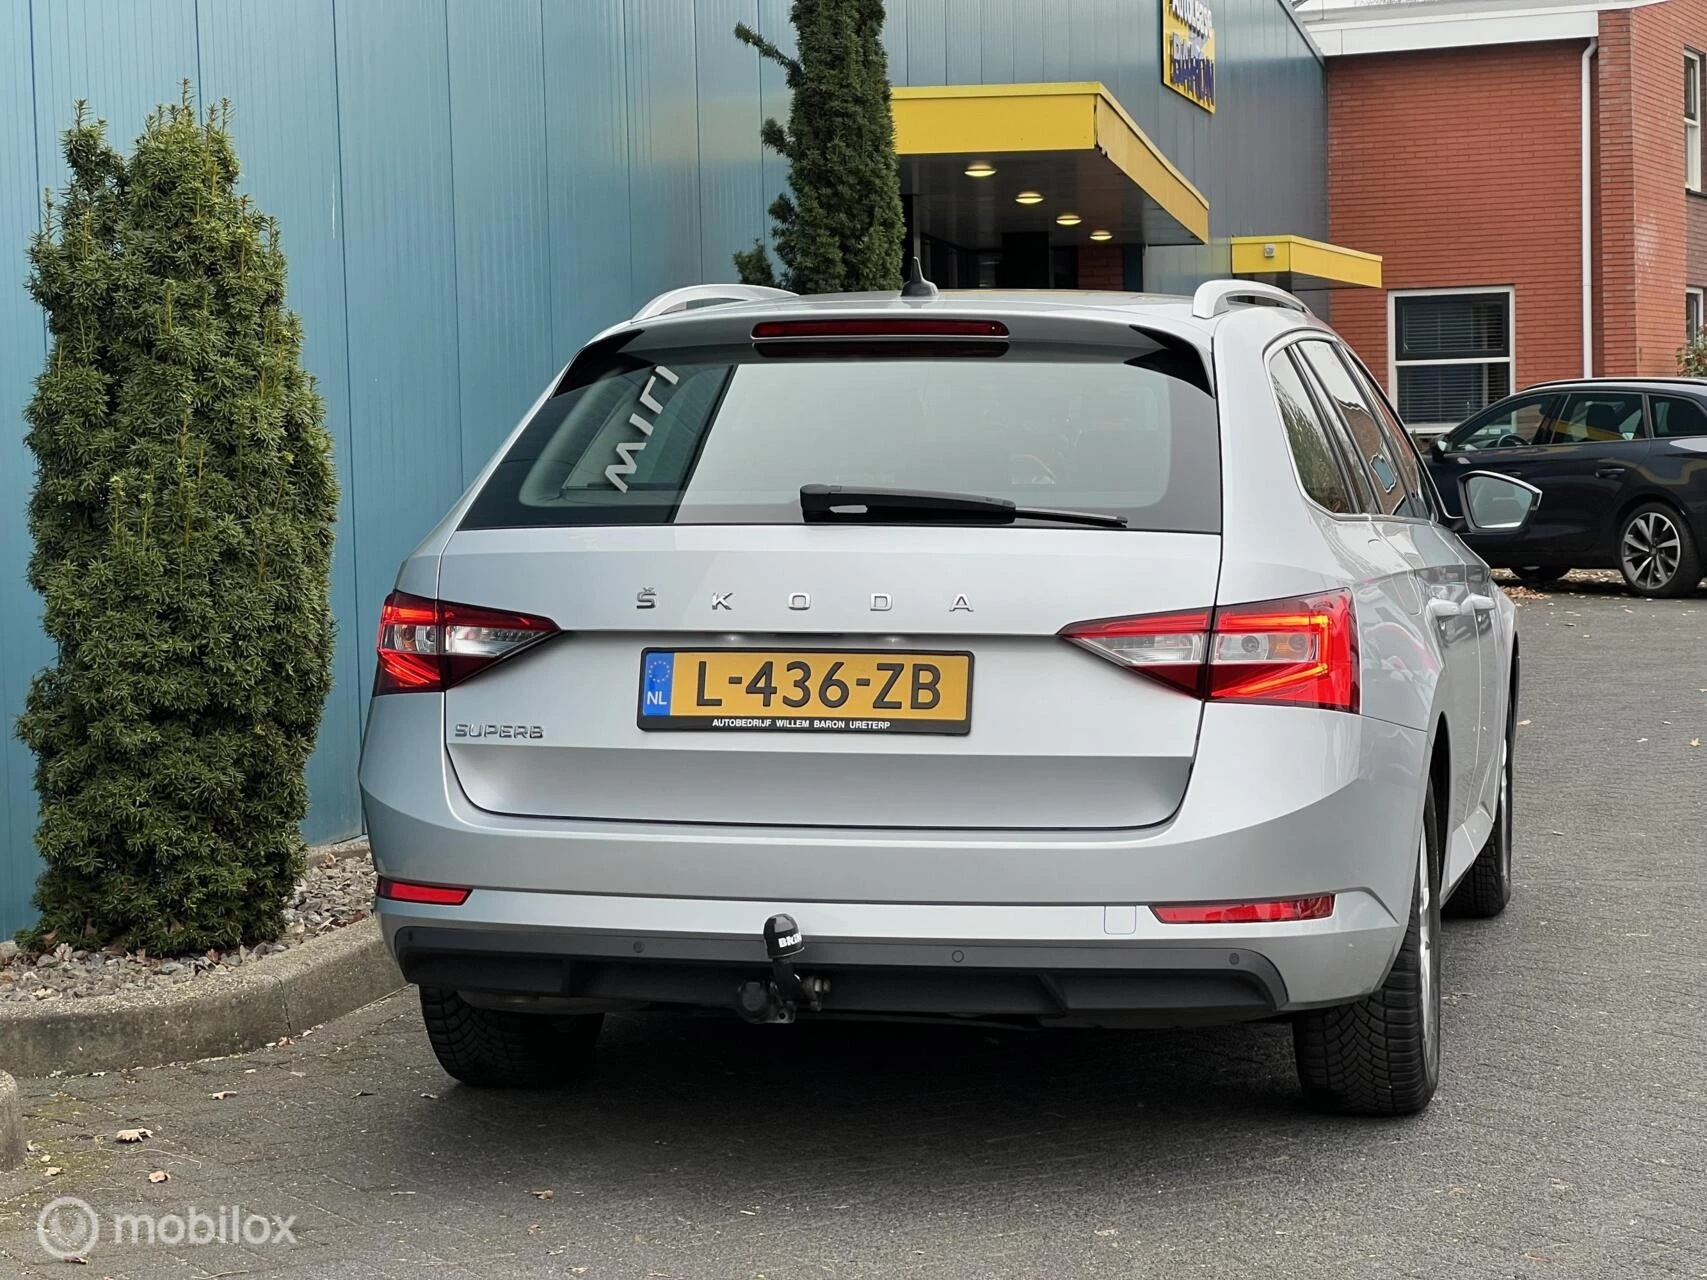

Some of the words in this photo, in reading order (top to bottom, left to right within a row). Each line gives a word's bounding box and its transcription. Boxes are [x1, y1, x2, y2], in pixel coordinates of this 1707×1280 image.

[696, 660, 943, 710] L-436-ZB
[646, 691, 668, 705] NL
[455, 723, 544, 739] SUPERB
[712, 718, 772, 728] AUTOBEDRIJF
[776, 719, 810, 729] WILLEM
[814, 720, 846, 729] BARON
[850, 721, 891, 730] URETERP
